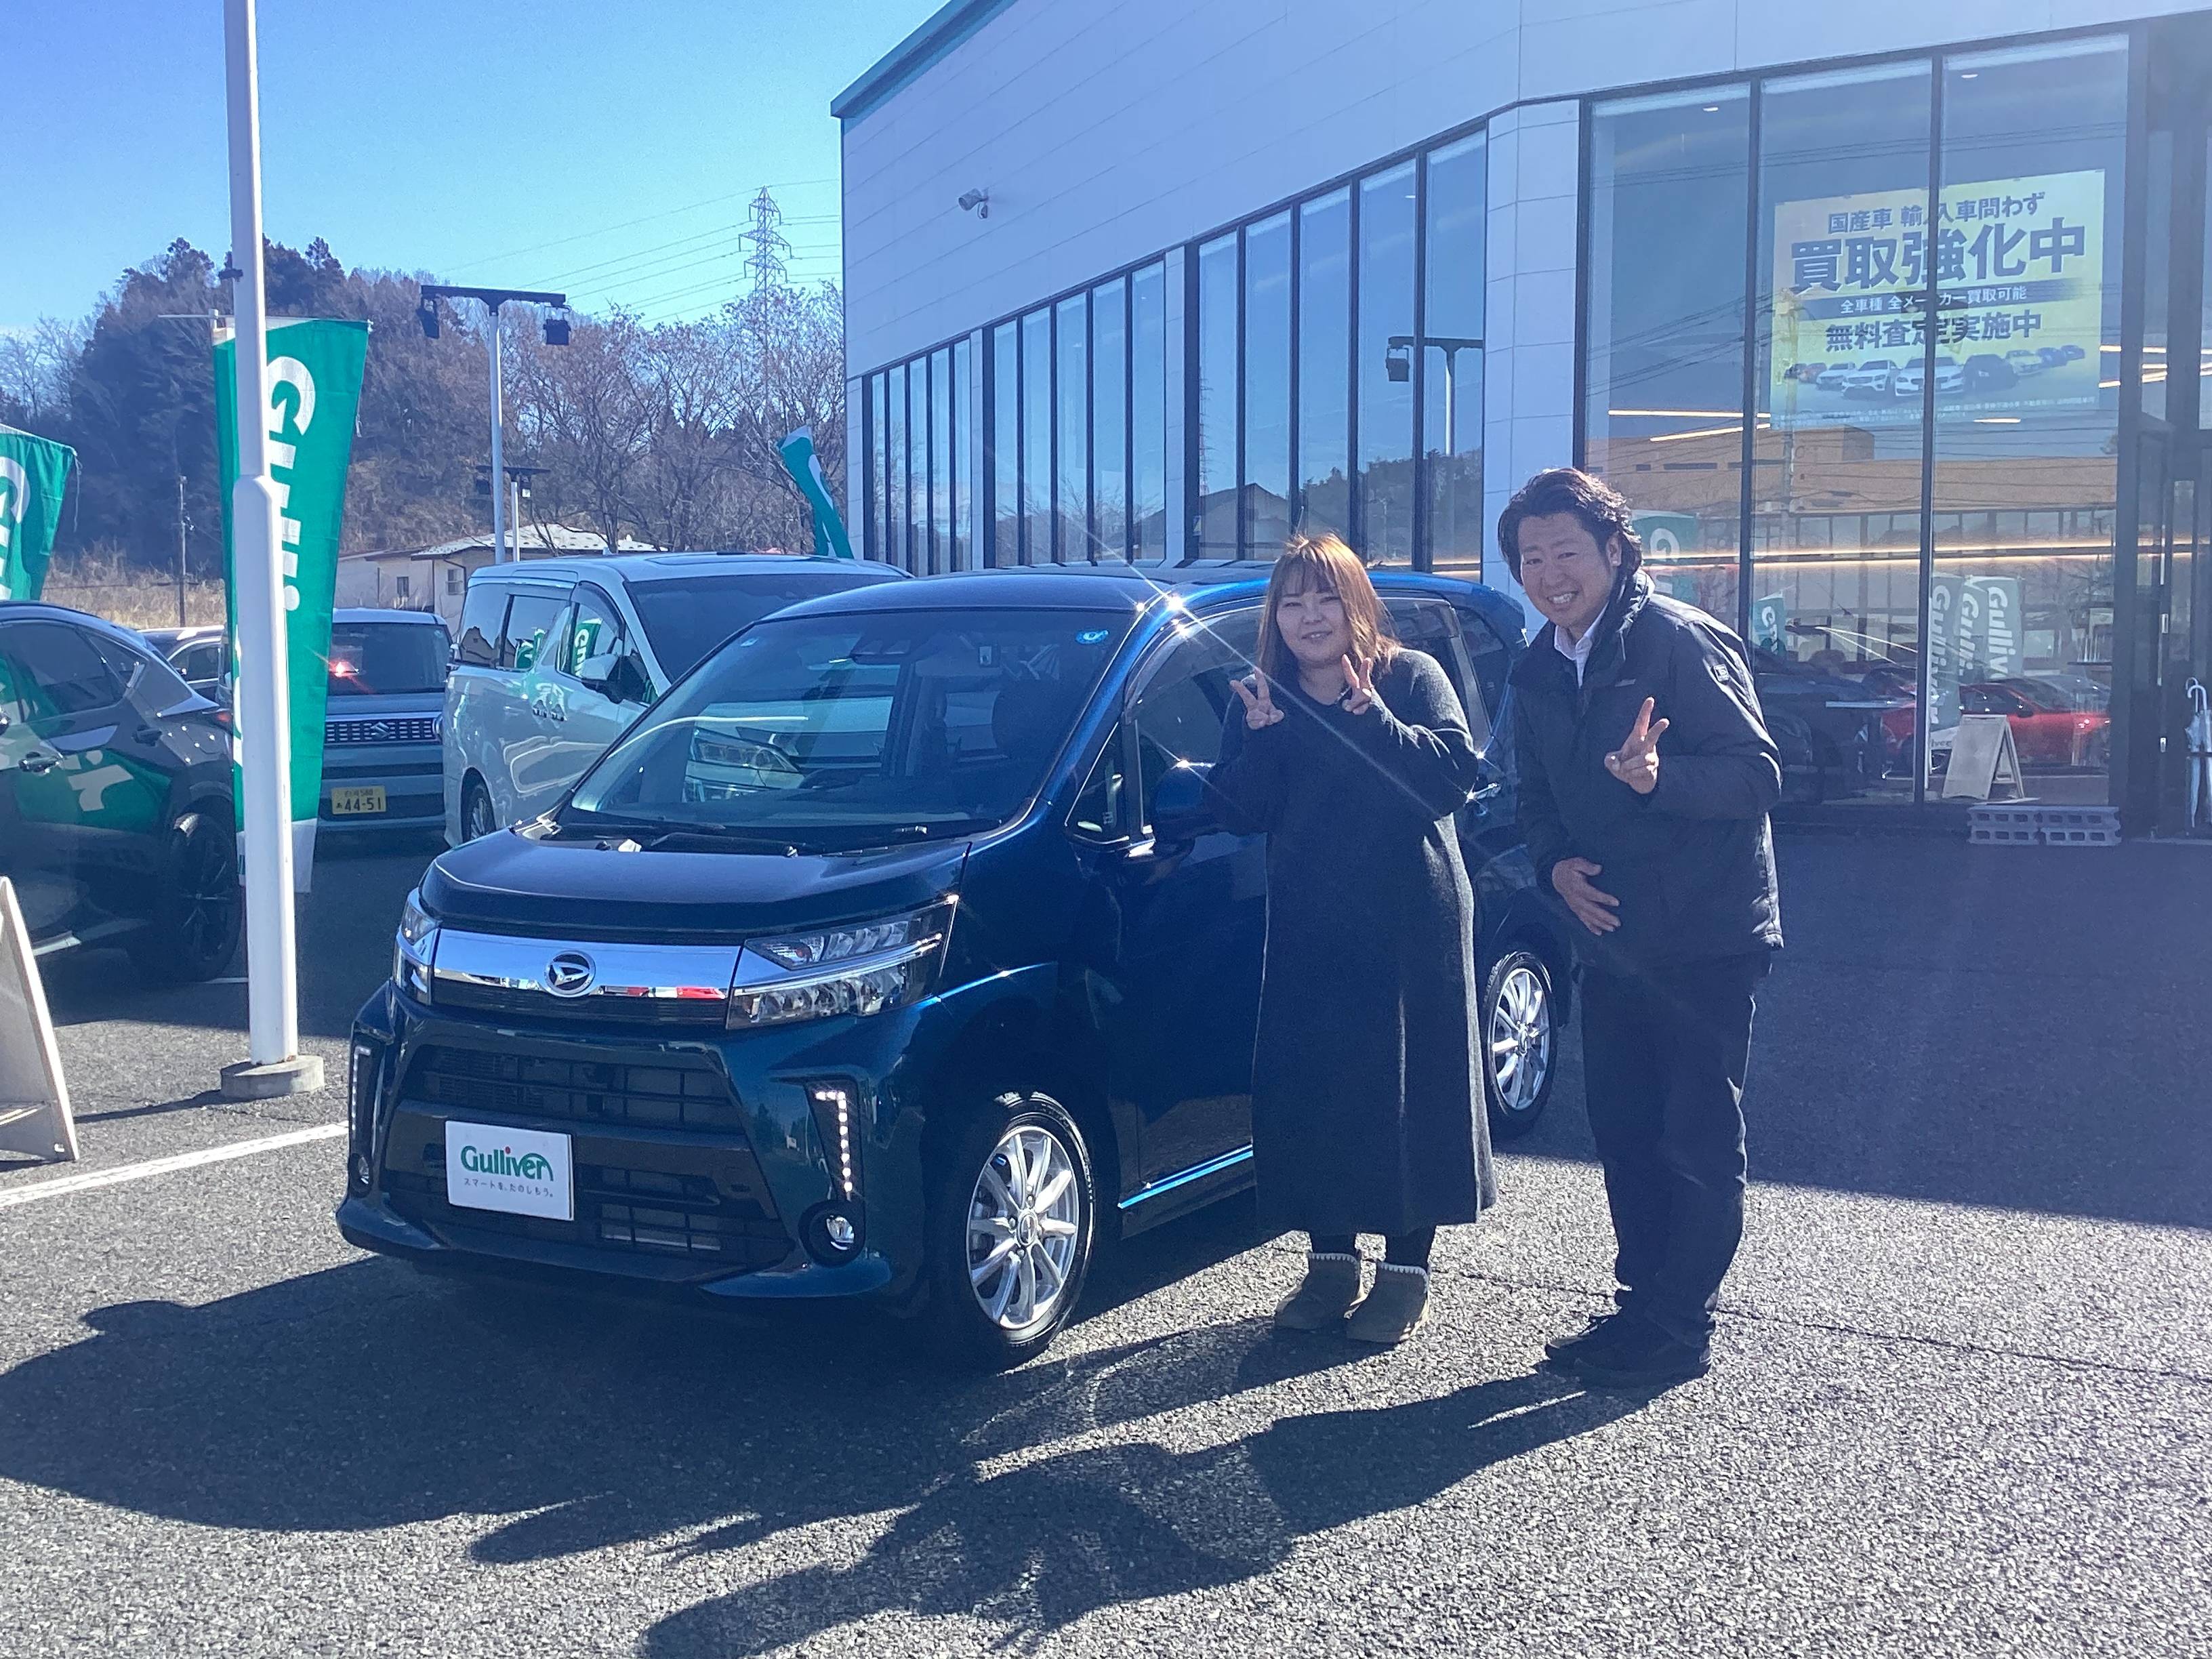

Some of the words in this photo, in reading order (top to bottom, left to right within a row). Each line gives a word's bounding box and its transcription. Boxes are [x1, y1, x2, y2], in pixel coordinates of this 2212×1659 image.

[1828, 208, 1893, 234] 国産車
[1790, 216, 2085, 295] 買取強化中
[1840, 297, 1883, 315] 全車種
[1887, 285, 2028, 312] 全メーカー買取可能
[1825, 308, 2042, 352] 無料査定実施中
[344, 796, 382, 811] 44-51
[461, 1145, 554, 1182] Gulliver
